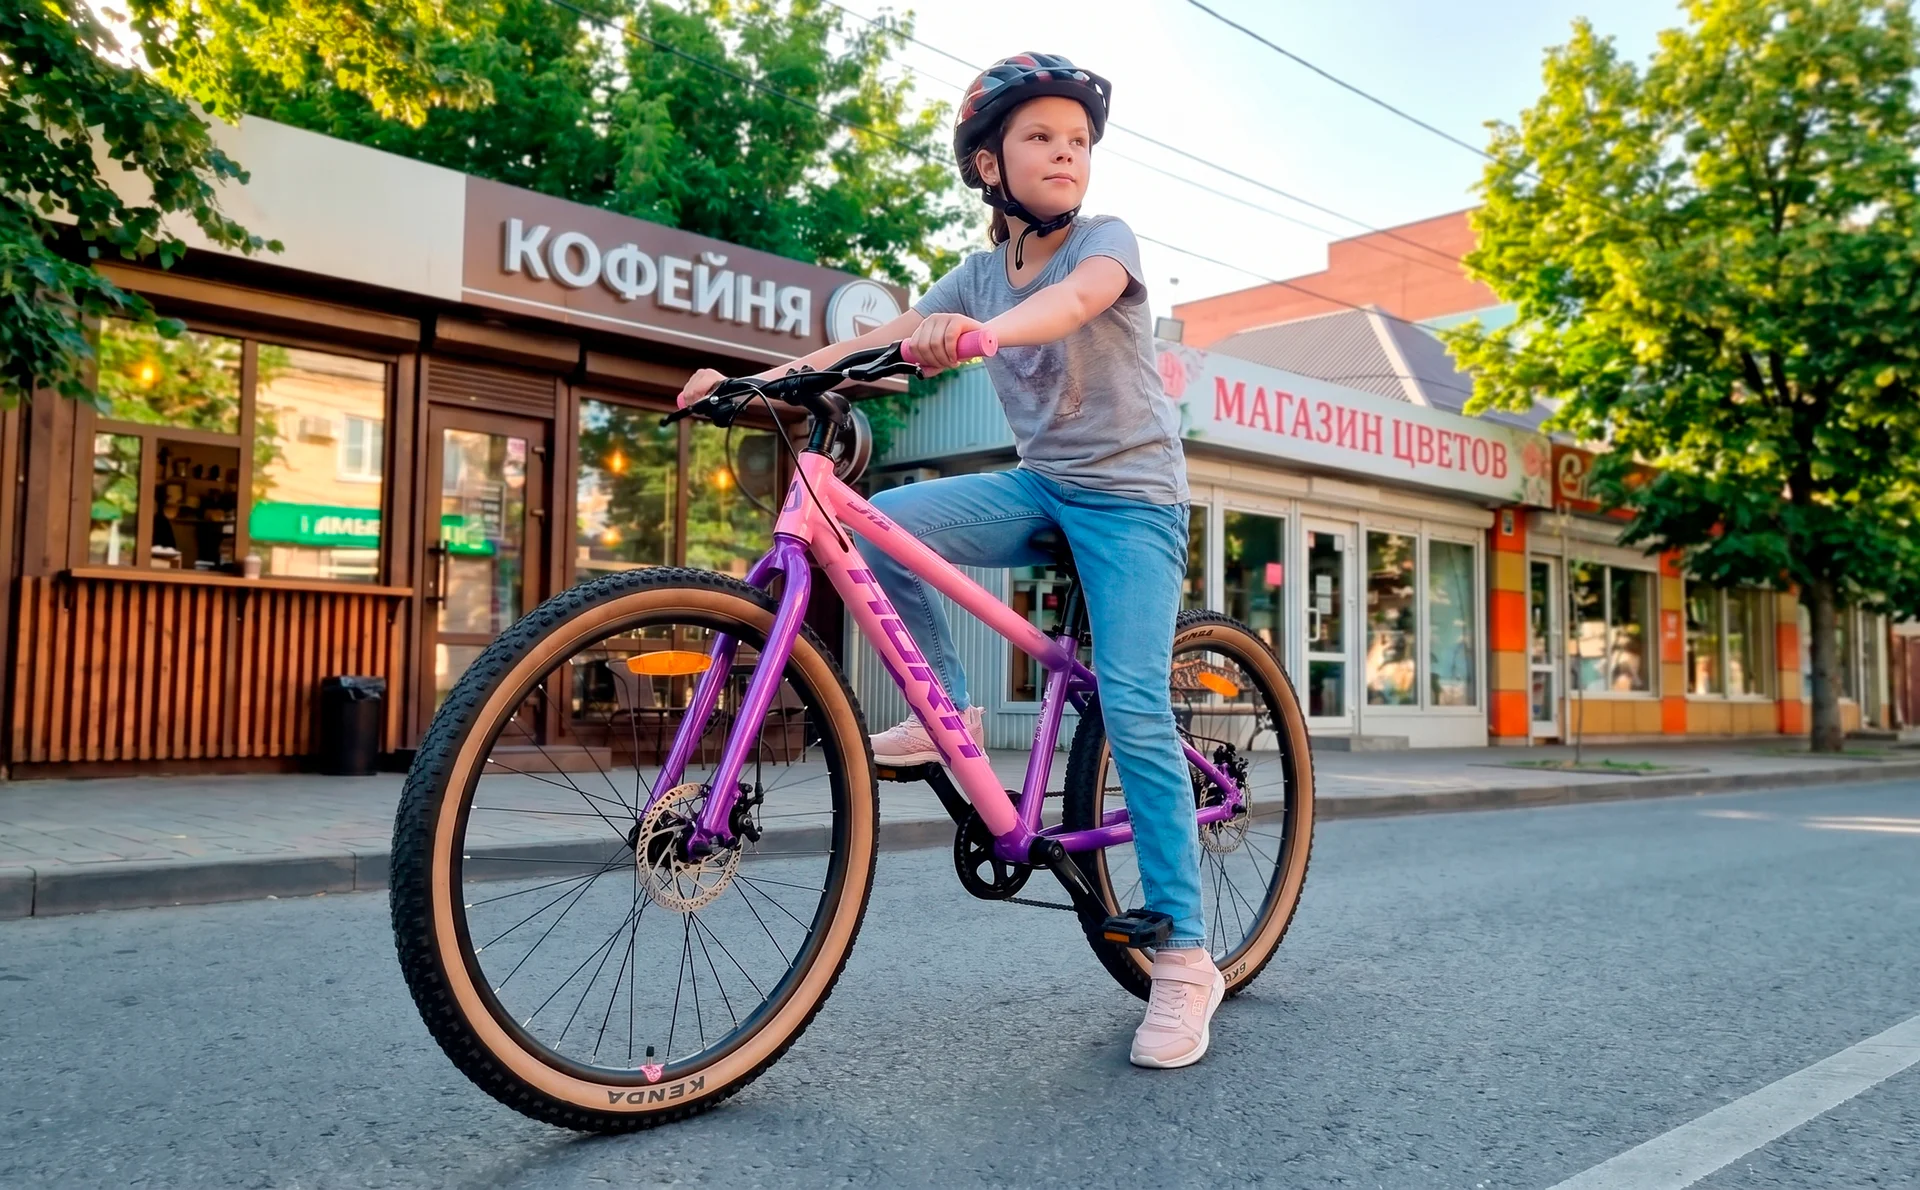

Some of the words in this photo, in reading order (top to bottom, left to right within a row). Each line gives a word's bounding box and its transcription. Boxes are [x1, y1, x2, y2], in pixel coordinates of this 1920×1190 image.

[504, 217, 811, 337] КОФЕЙНЯ
[1213, 376, 1384, 455] МАГАЗИН
[1392, 419, 1509, 480] ЦВЕТОВ
[607, 1075, 705, 1105] KENDA
